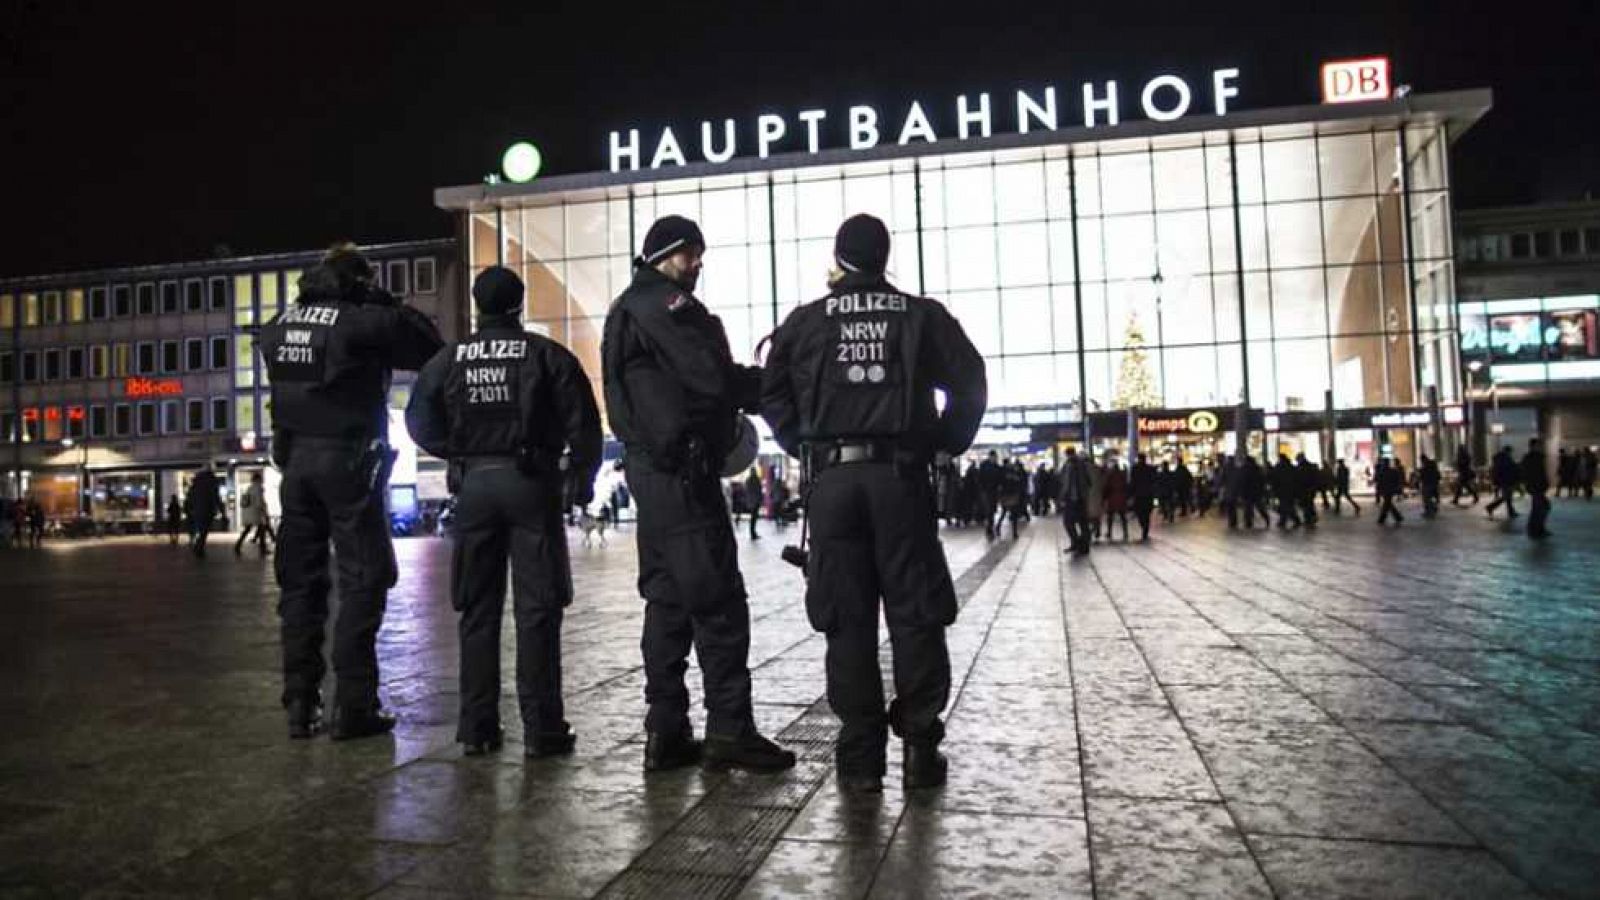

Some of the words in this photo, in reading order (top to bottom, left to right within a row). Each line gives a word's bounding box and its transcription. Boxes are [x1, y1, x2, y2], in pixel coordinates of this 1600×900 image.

[1332, 66, 1380, 97] DB
[608, 68, 1240, 174] HAUPTBAHNHOF
[825, 292, 907, 317] POLIZEI
[286, 329, 312, 345] NRW
[840, 321, 888, 341] NRW
[277, 345, 313, 363] 21011
[456, 340, 527, 362] POLIZEI
[836, 342, 885, 362] 21011
[466, 366, 507, 384] NRW
[467, 385, 510, 404] 21011
[1137, 417, 1187, 432] Kamps
